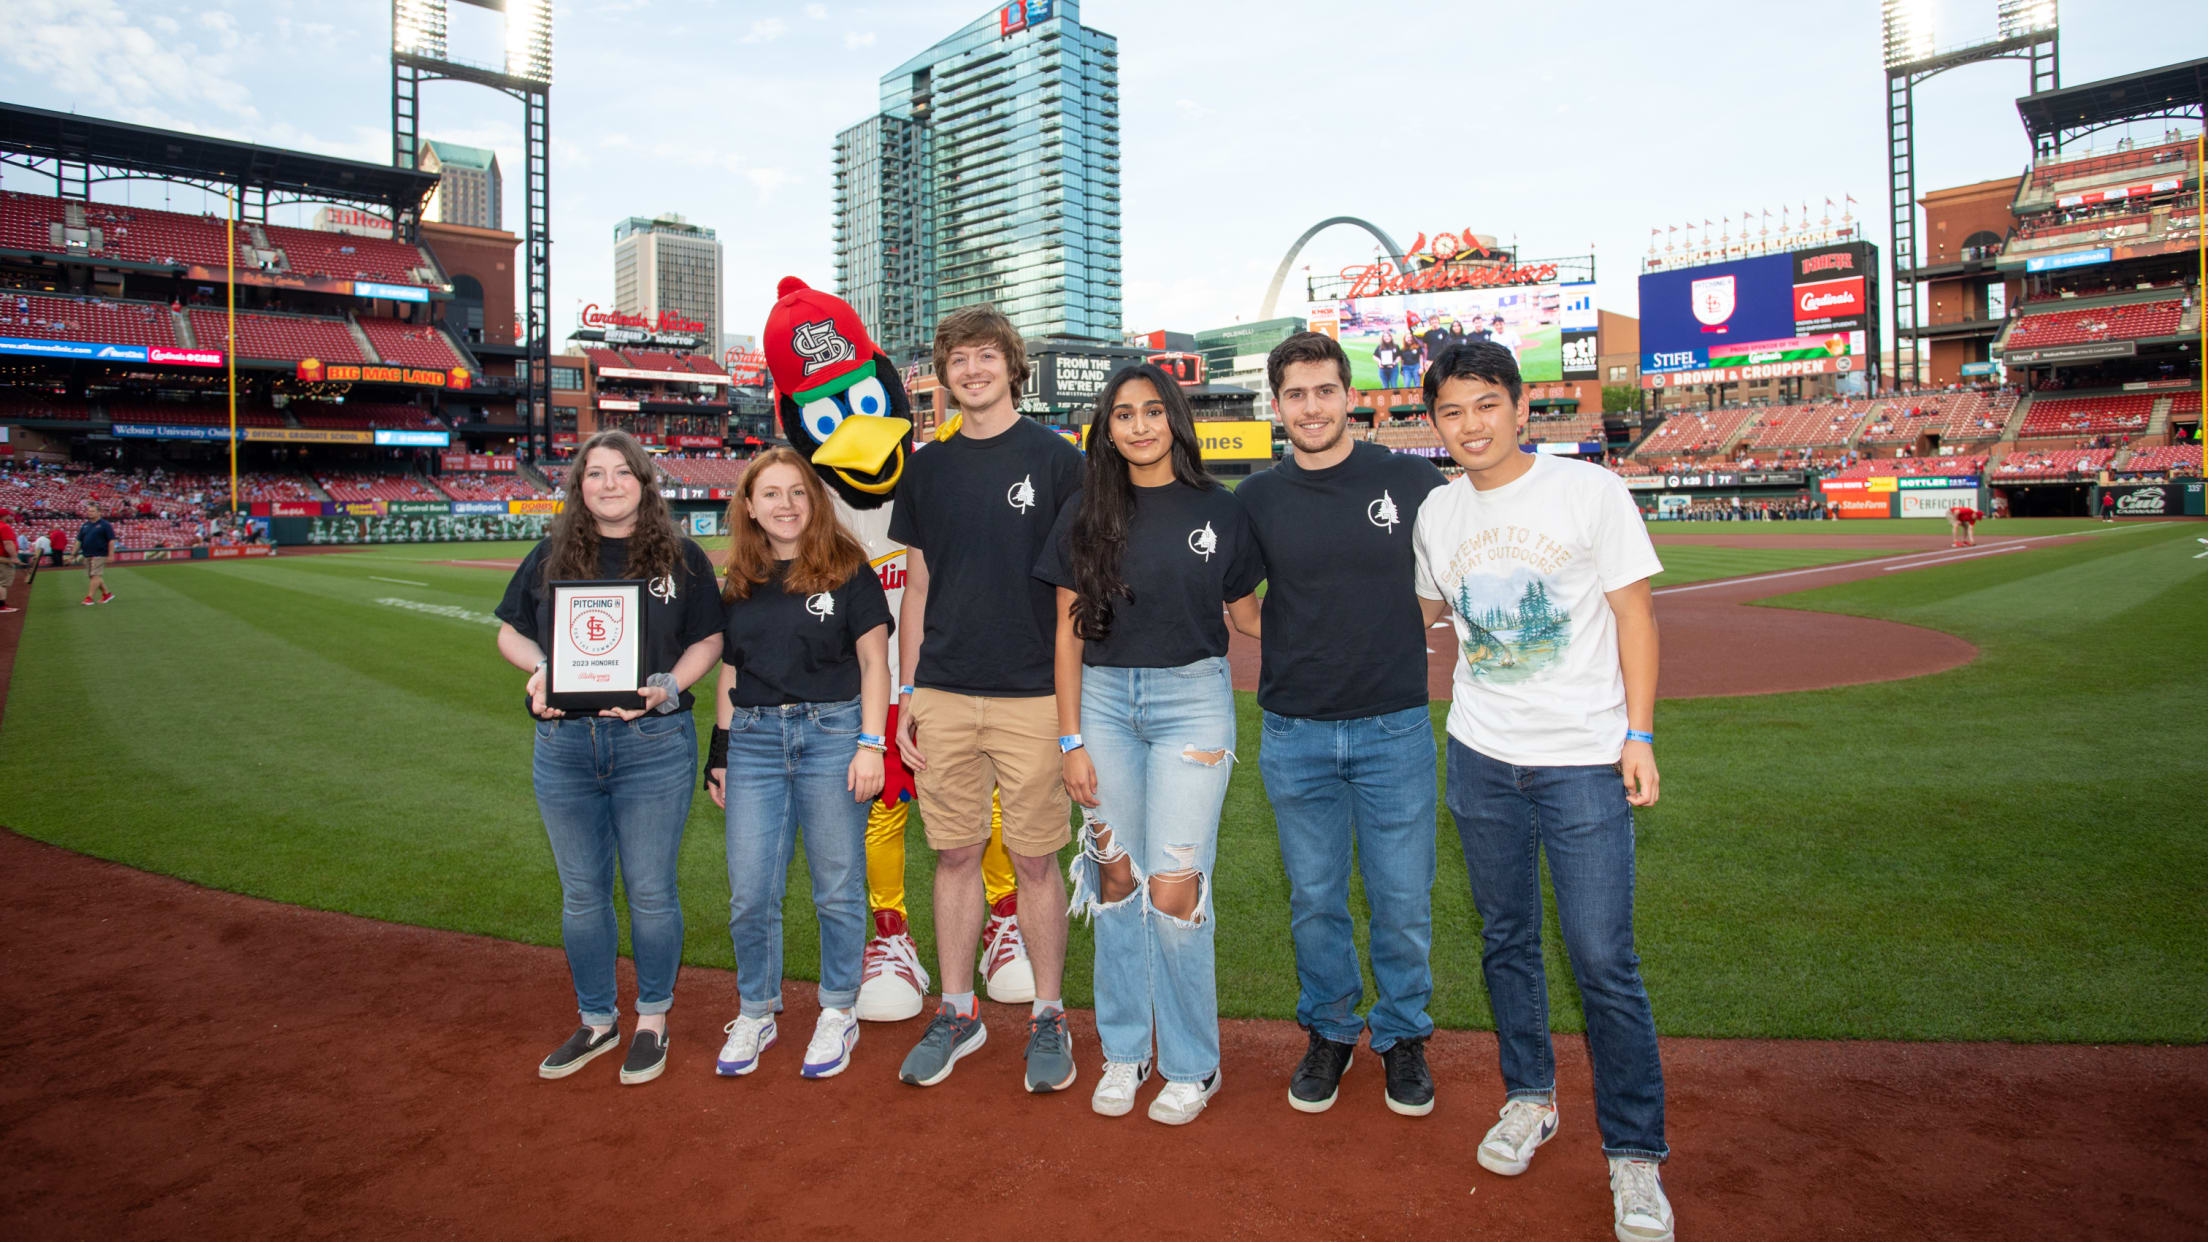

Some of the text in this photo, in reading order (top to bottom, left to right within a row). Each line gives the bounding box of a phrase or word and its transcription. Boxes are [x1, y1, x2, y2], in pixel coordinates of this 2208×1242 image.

[328, 208, 392, 230] Hilton
[1340, 260, 1558, 298] Budweiser
[1801, 290, 1855, 312] Cardinals
[582, 303, 704, 333] Cardinals Nation
[1056, 357, 1111, 371] FROM THE
[1653, 351, 1697, 368] STIFEL
[2012, 353, 2033, 363] Mercy
[327, 366, 445, 387] BIG MAC LAND
[1056, 368, 1105, 381] LOU AND
[1673, 369, 1725, 386] BROWN
[1728, 370, 1739, 381] &
[1742, 360, 1824, 379] CROUPPEN
[1056, 380, 1088, 392] WE'RE
[114, 424, 155, 436] Webster
[157, 426, 206, 438] University
[1403, 447, 1437, 458] LOUIS
[401, 503, 449, 512] Central Bank
[1440, 526, 1573, 584] GATEWAY TO THE
[1450, 546, 1556, 588] GREAT OUTDOORS
[573, 599, 613, 608] PITCHING
[591, 659, 620, 667] HONOREE
